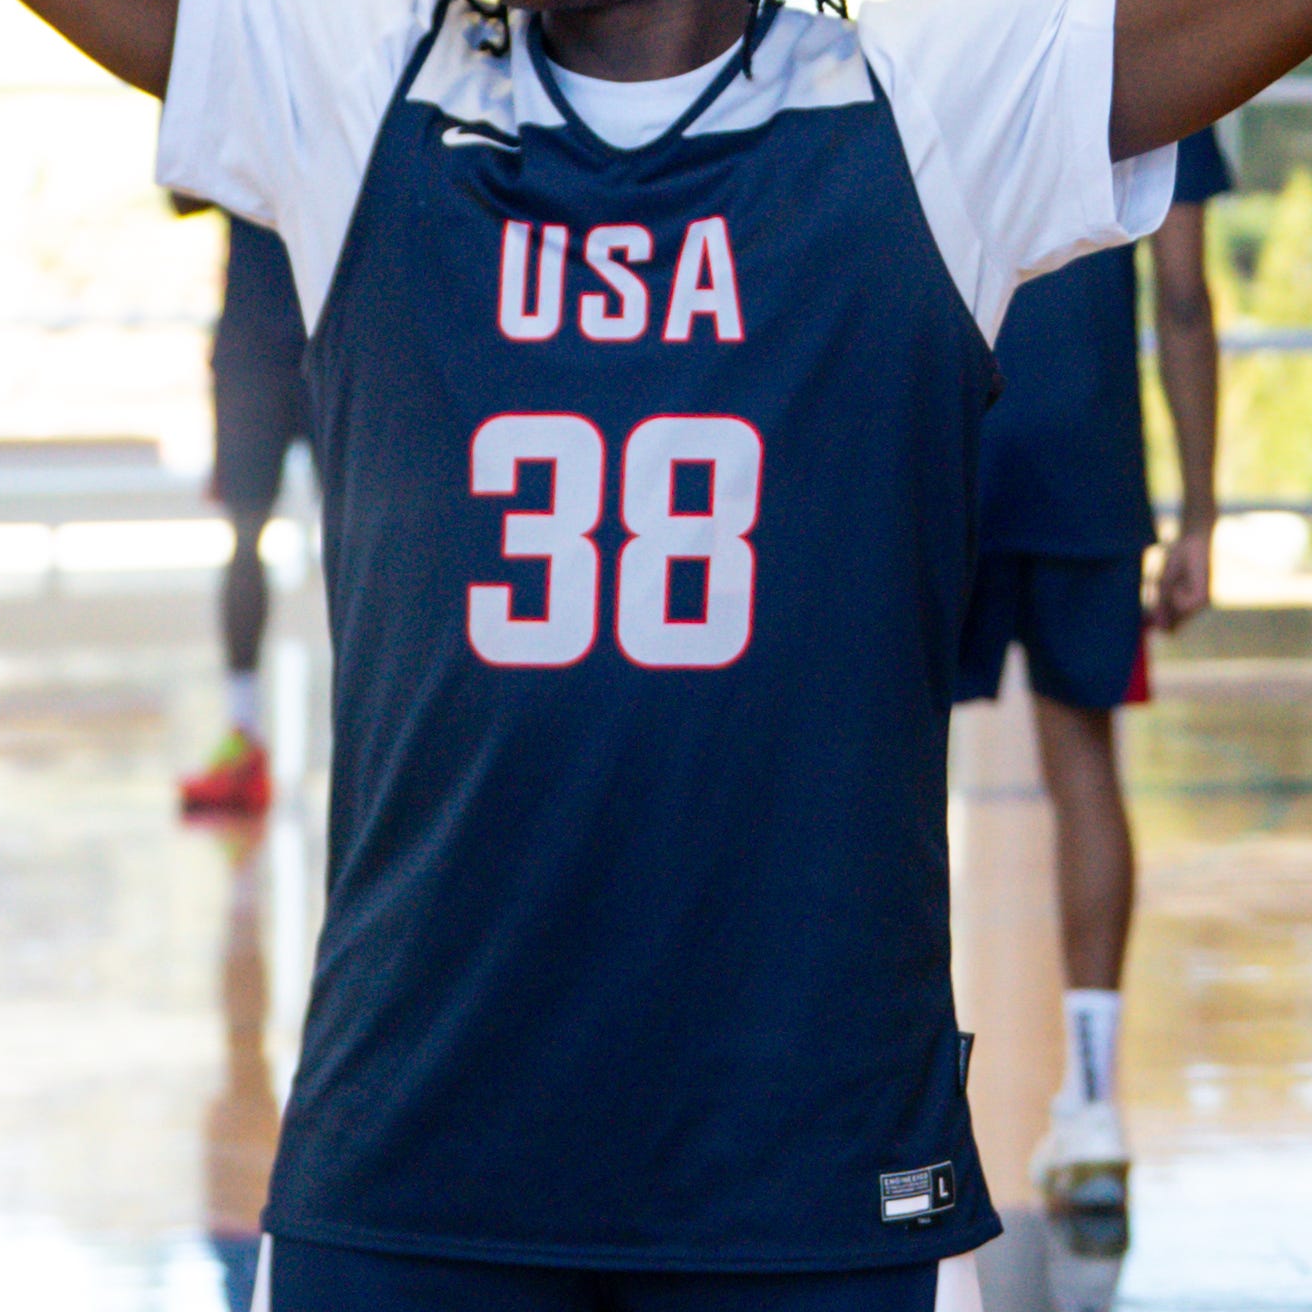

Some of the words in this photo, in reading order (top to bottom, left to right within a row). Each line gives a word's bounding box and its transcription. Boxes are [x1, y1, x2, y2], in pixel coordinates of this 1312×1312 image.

[498, 216, 745, 342] USA
[467, 412, 764, 668] 38
[938, 1177, 949, 1197] L
